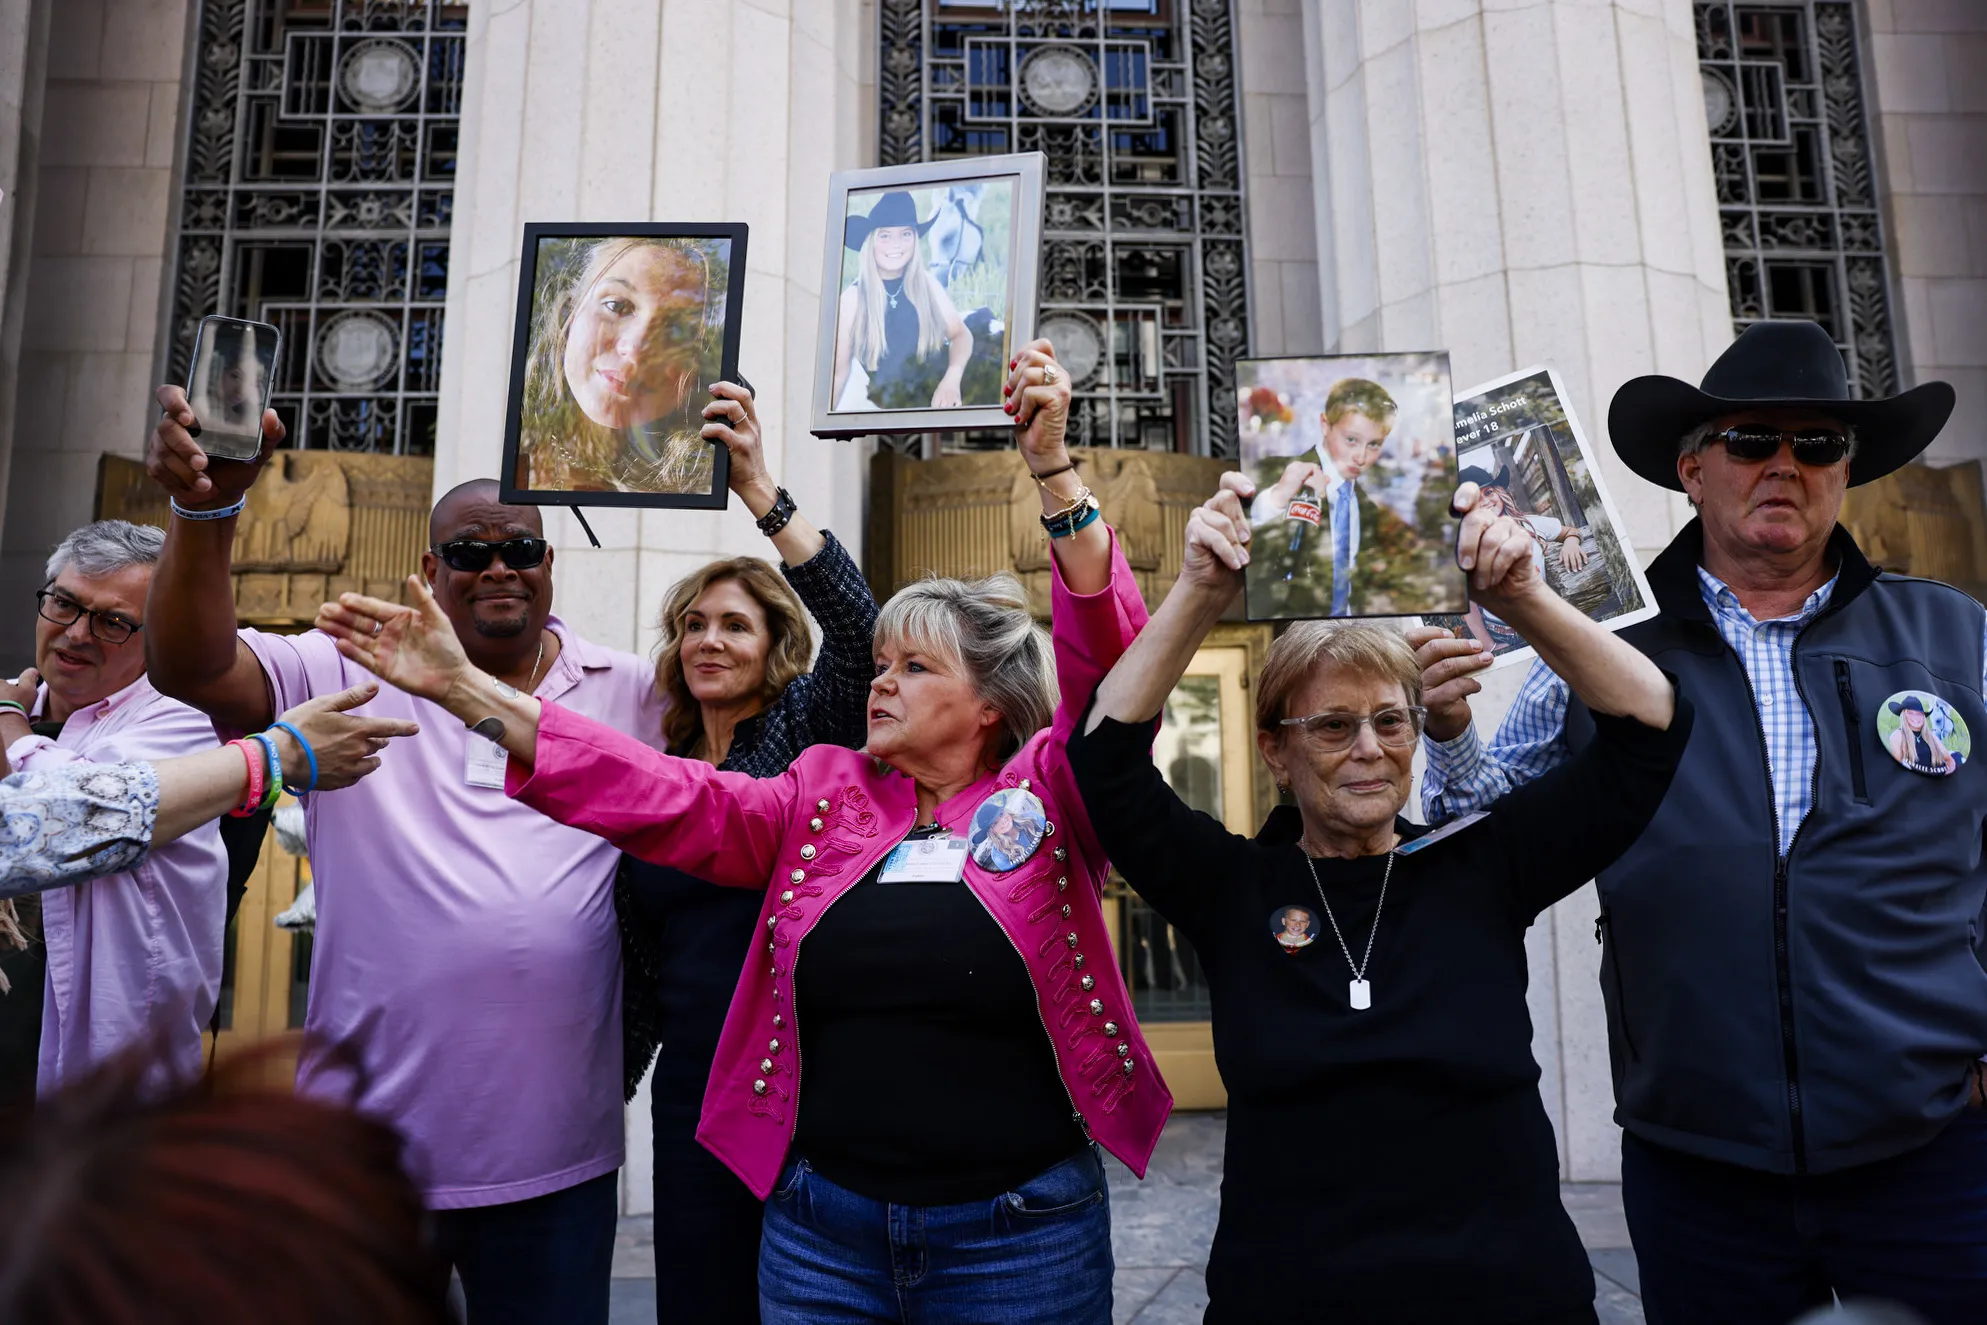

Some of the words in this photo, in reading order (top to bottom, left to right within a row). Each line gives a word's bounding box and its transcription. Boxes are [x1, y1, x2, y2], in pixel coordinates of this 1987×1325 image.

[1455, 411, 1488, 430] melia
[1489, 396, 1527, 416] Schott
[1483, 421, 1499, 434] 18
